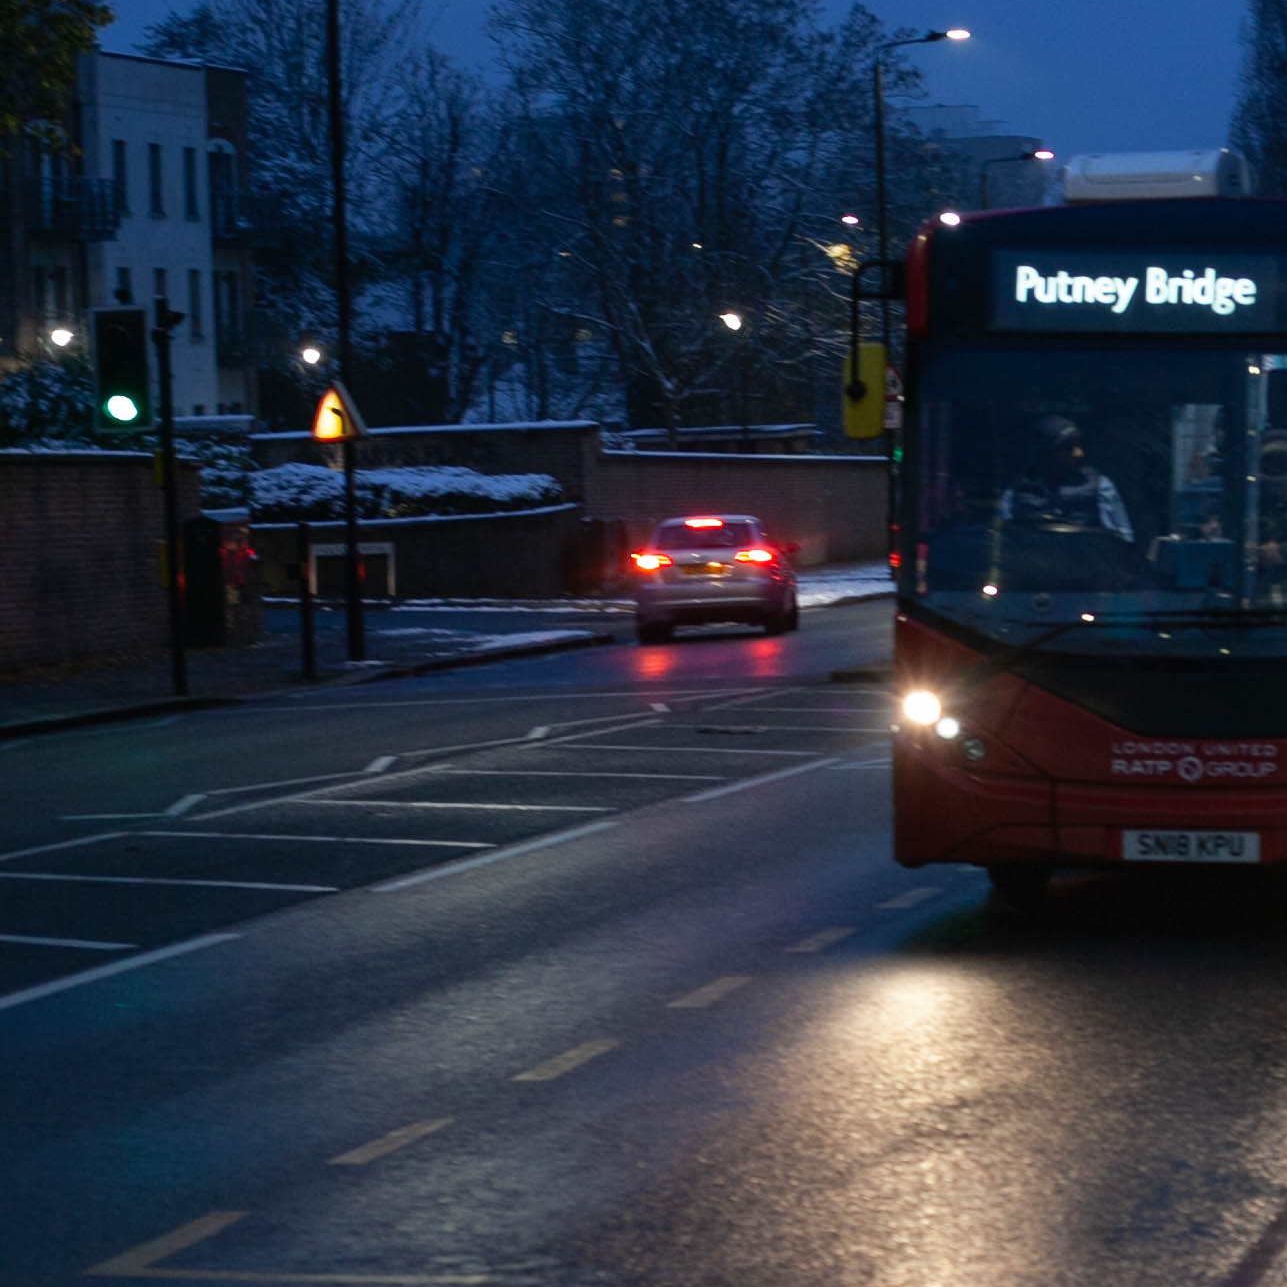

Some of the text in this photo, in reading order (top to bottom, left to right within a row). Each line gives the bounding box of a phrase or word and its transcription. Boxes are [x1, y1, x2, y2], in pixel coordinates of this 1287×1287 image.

[1014, 265, 1257, 315] Putney Bridge
[1112, 742, 1277, 757] LONDON UNITED
[1111, 759, 1278, 778] RATP GROUP
[1138, 834, 1246, 858] SN18 KPU
